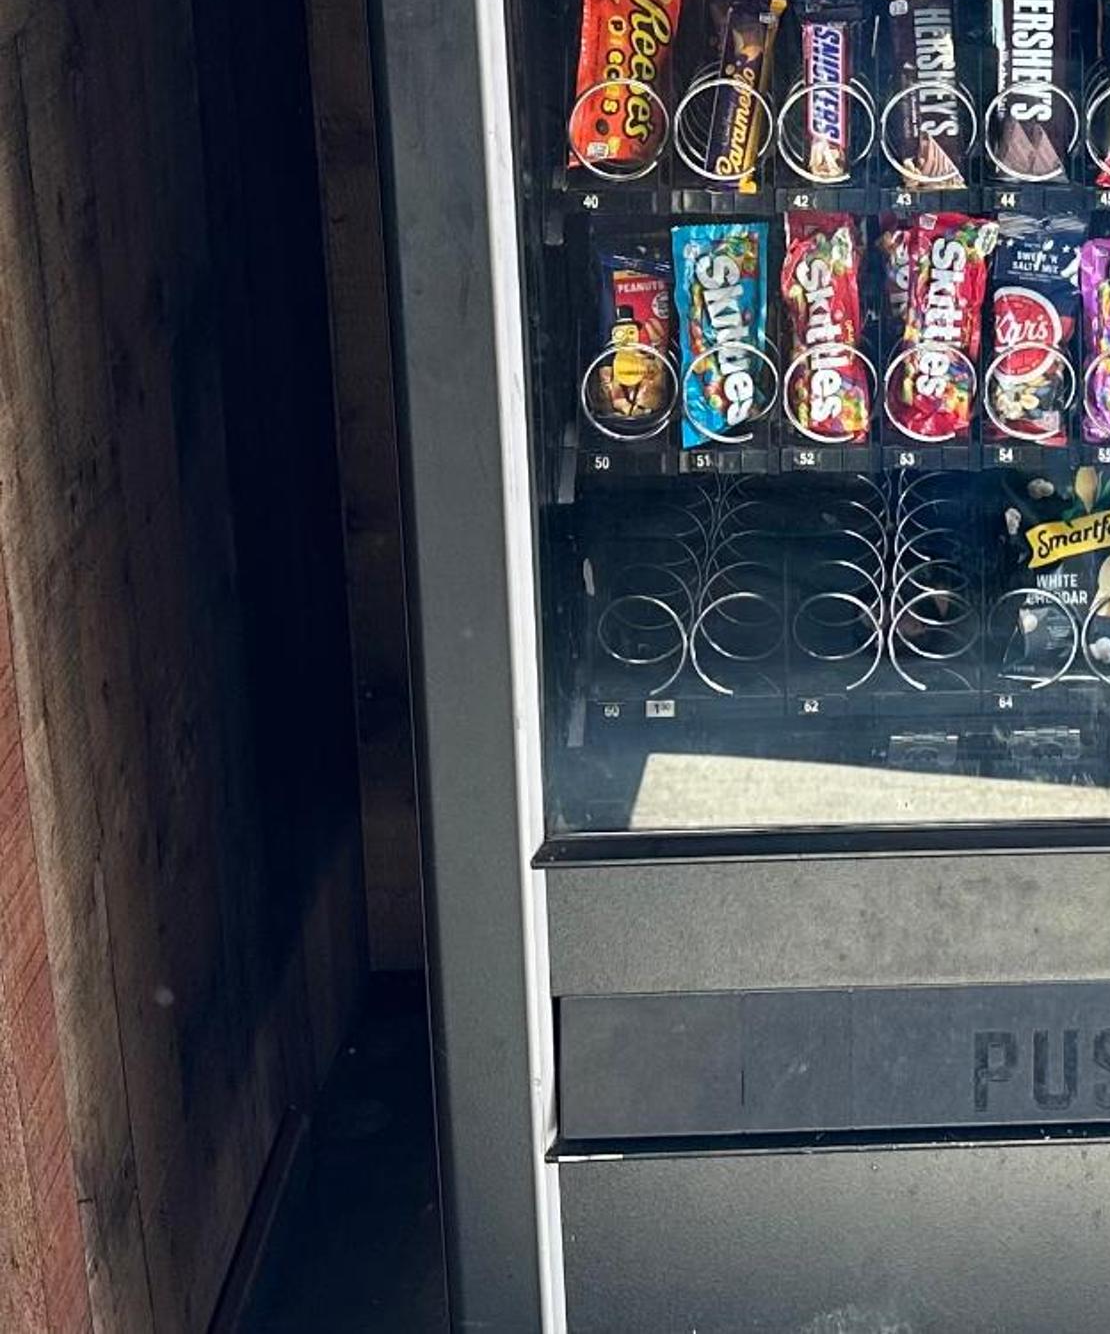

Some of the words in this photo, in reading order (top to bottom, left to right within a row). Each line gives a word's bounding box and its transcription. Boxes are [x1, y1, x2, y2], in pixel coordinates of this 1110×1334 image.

[913, 8, 959, 137] HERSHEY'S
[812, 24, 844, 145] SNICKERS
[715, 66, 756, 175] Caramello
[583, 195, 599, 208] 40
[793, 194, 809, 208] 42
[897, 193, 912, 206] 43
[1000, 193, 1016, 207] 44
[796, 259, 853, 422] Skittles
[696, 455, 711, 467] 51
[799, 453, 815, 465] 52
[899, 453, 915, 466] 53
[999, 449, 1014, 462] 54
[595, 456, 610, 470] 50
[1036, 573, 1078, 589] WHITE
[1026, 590, 1088, 606] CHEDAR
[803, 699, 819, 713] 62
[999, 696, 1013, 709] 64
[604, 705, 620, 717] 60
